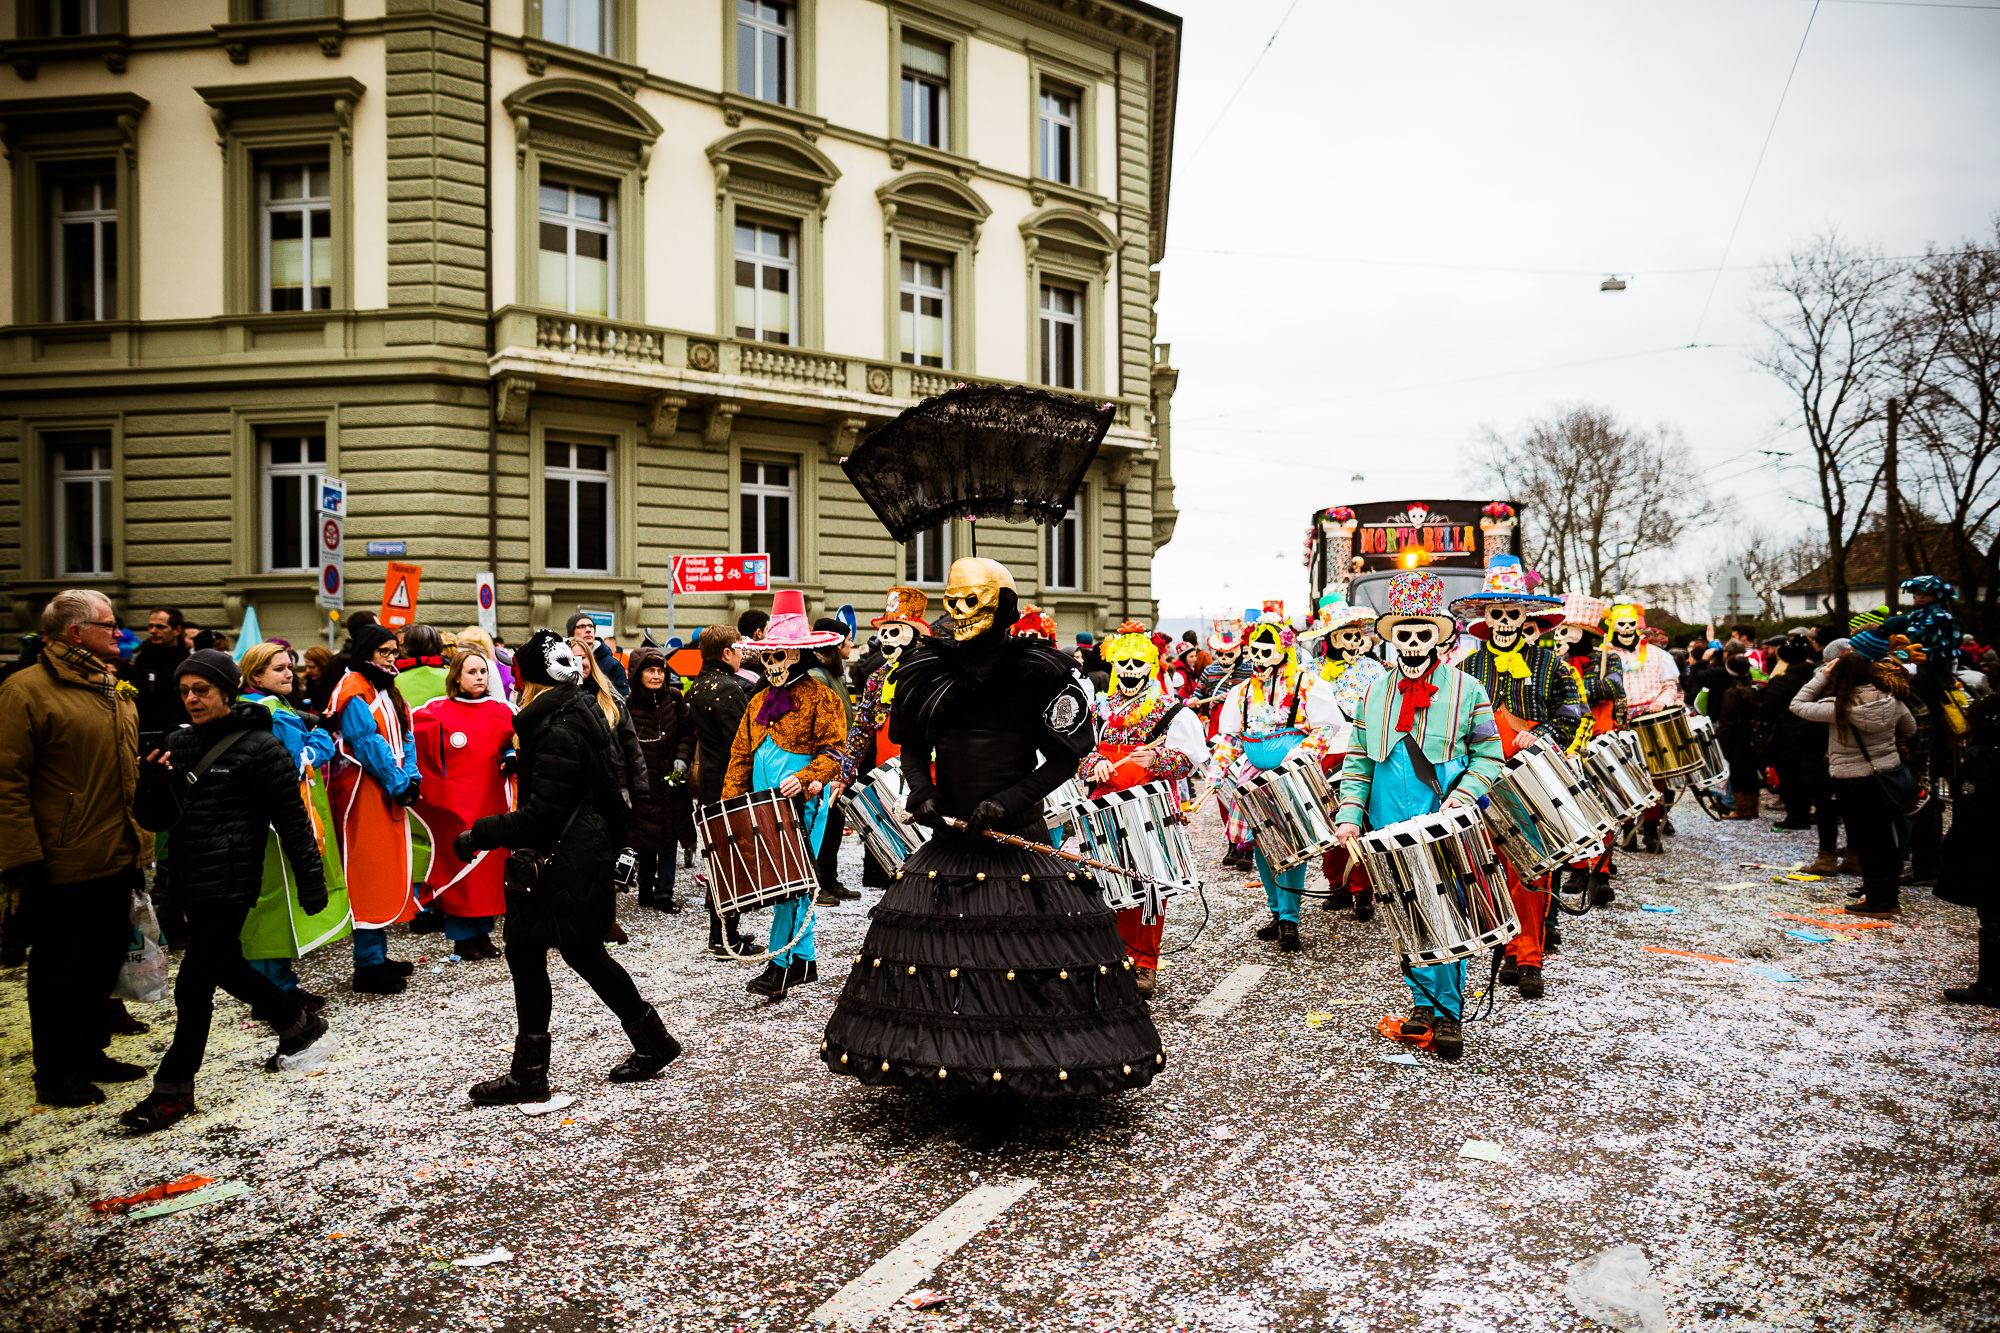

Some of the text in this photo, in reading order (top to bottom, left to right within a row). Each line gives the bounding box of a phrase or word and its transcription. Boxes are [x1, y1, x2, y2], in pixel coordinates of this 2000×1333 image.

[1360, 526, 1476, 553] MORTA BELLA
[685, 558, 706, 567] Freiburg
[685, 574, 713, 582] Saint-Louis
[685, 583, 696, 592] City
